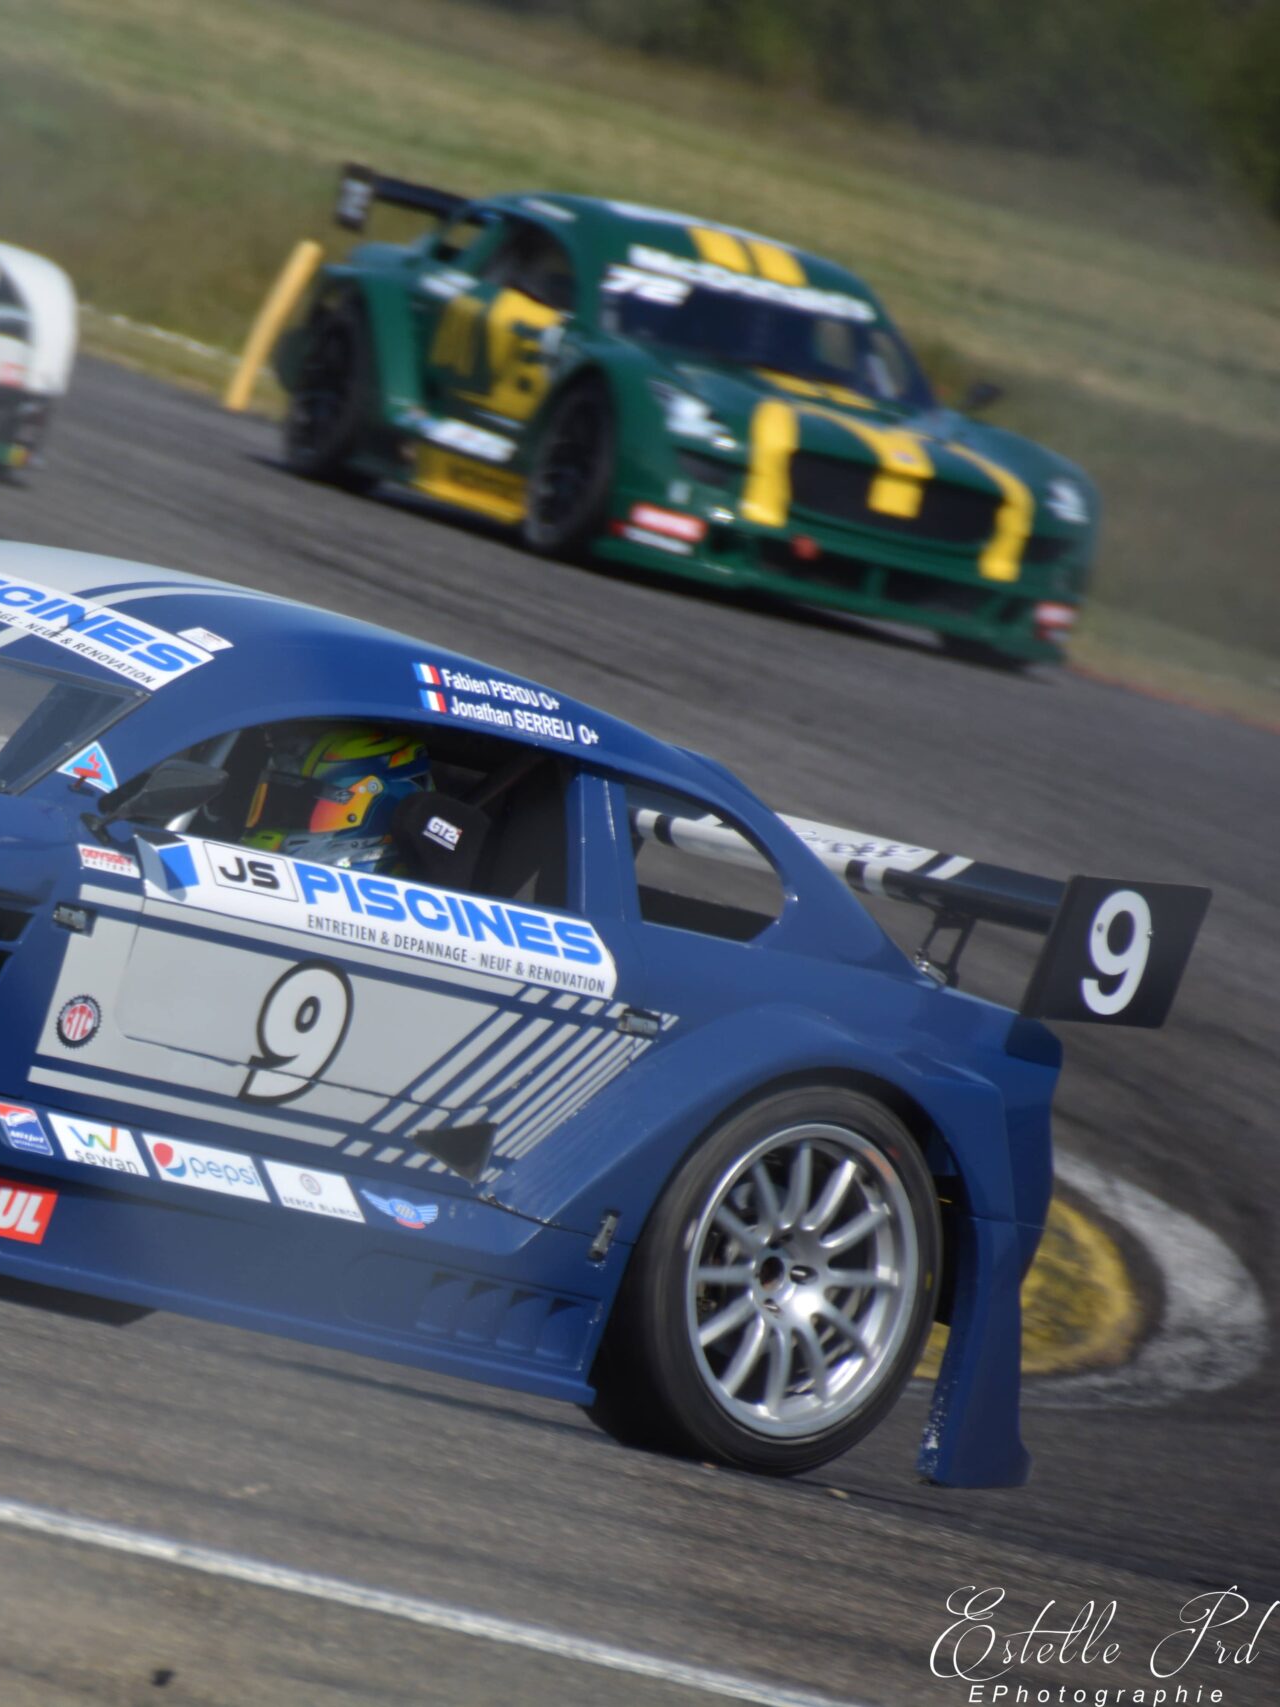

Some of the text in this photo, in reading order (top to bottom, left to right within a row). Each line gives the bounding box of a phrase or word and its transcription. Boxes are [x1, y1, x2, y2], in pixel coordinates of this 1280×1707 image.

[26, 622, 61, 640] NEUF
[61, 634, 73, 646] &
[73, 642, 157, 684] RENOVATION
[441, 669, 560, 711] Fabien PERDU O+
[451, 696, 513, 727] Jonathan
[513, 709, 575, 741] SERRELI
[219, 857, 602, 965] JS PISCINES
[307, 913, 377, 943] ENTRETIEN
[380, 932, 390, 945] &
[394, 934, 468, 964] DEPANNAGE
[480, 952, 512, 974] NEUF
[515, 962, 525, 976] &
[529, 964, 606, 994] RENOVATION
[1081, 889, 1152, 1016] 9
[237, 958, 354, 1107] 9
[74, 1149, 140, 1174] sewan
[189, 1156, 261, 1188] pepsi
